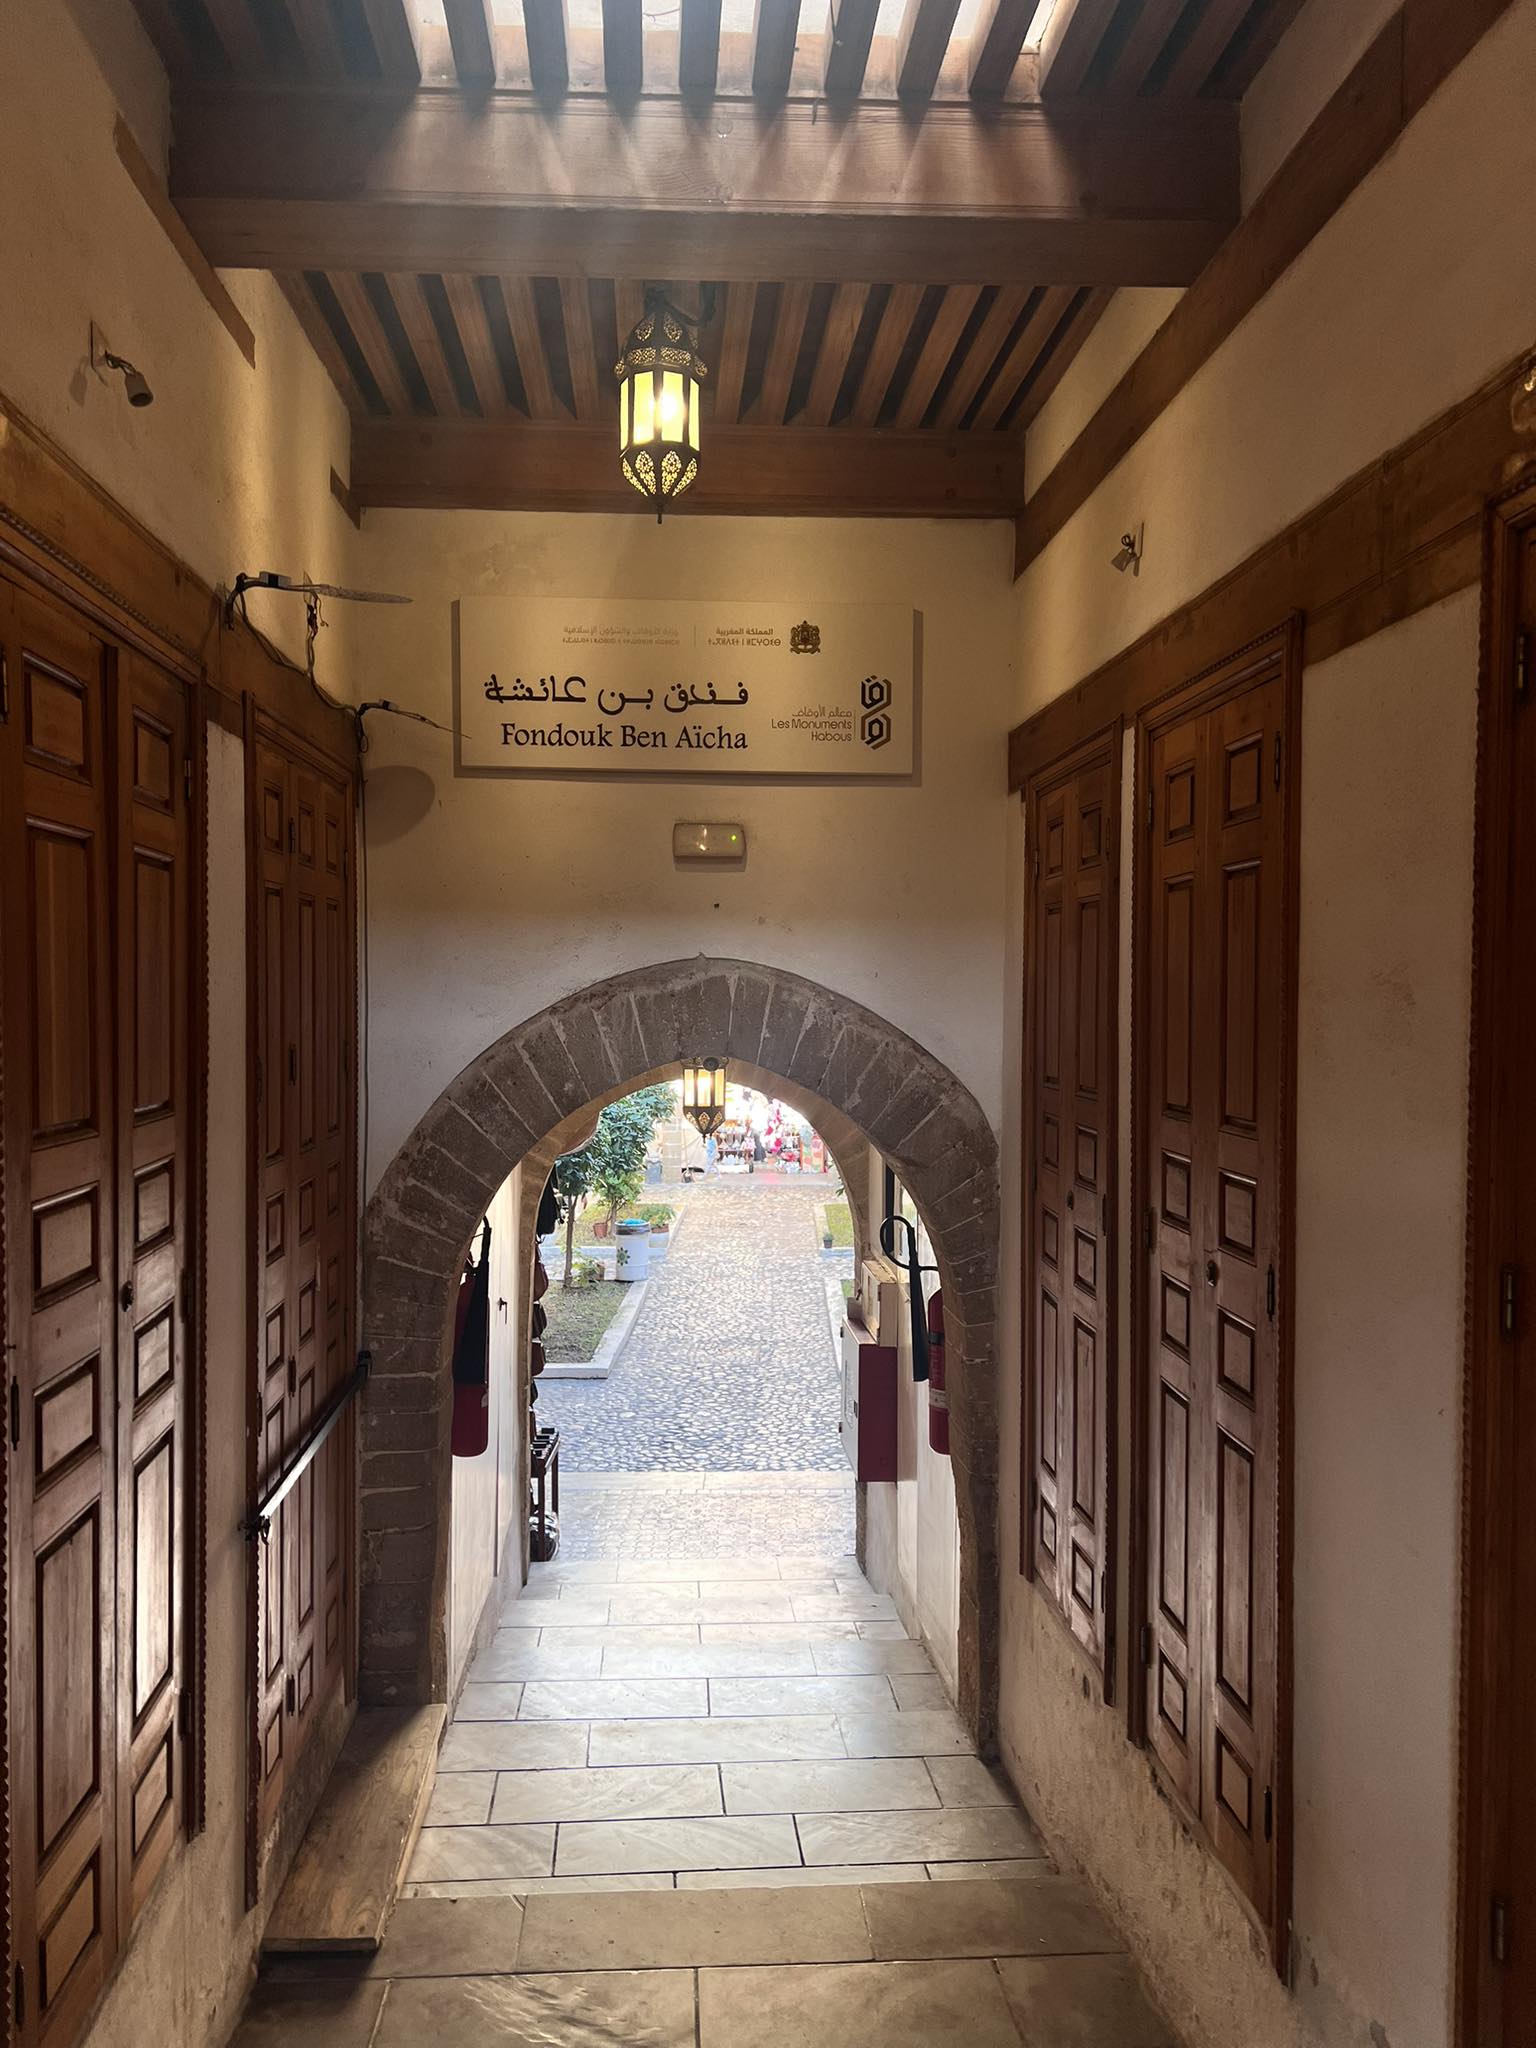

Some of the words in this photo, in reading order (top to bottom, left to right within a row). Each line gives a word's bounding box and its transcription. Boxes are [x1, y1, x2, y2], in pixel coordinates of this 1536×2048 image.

[746, 627, 774, 637] المملكة
[484, 673, 587, 705] عائشة
[664, 682, 749, 714] فندق
[597, 687, 654, 716] بن
[827, 706, 853, 719] معالم
[771, 718, 791, 730] Les
[791, 717, 853, 730] Monuments
[500, 722, 614, 748] Fondouk
[620, 725, 668, 748] Ben
[674, 724, 749, 750] Aïcha
[810, 730, 853, 742] Habous
